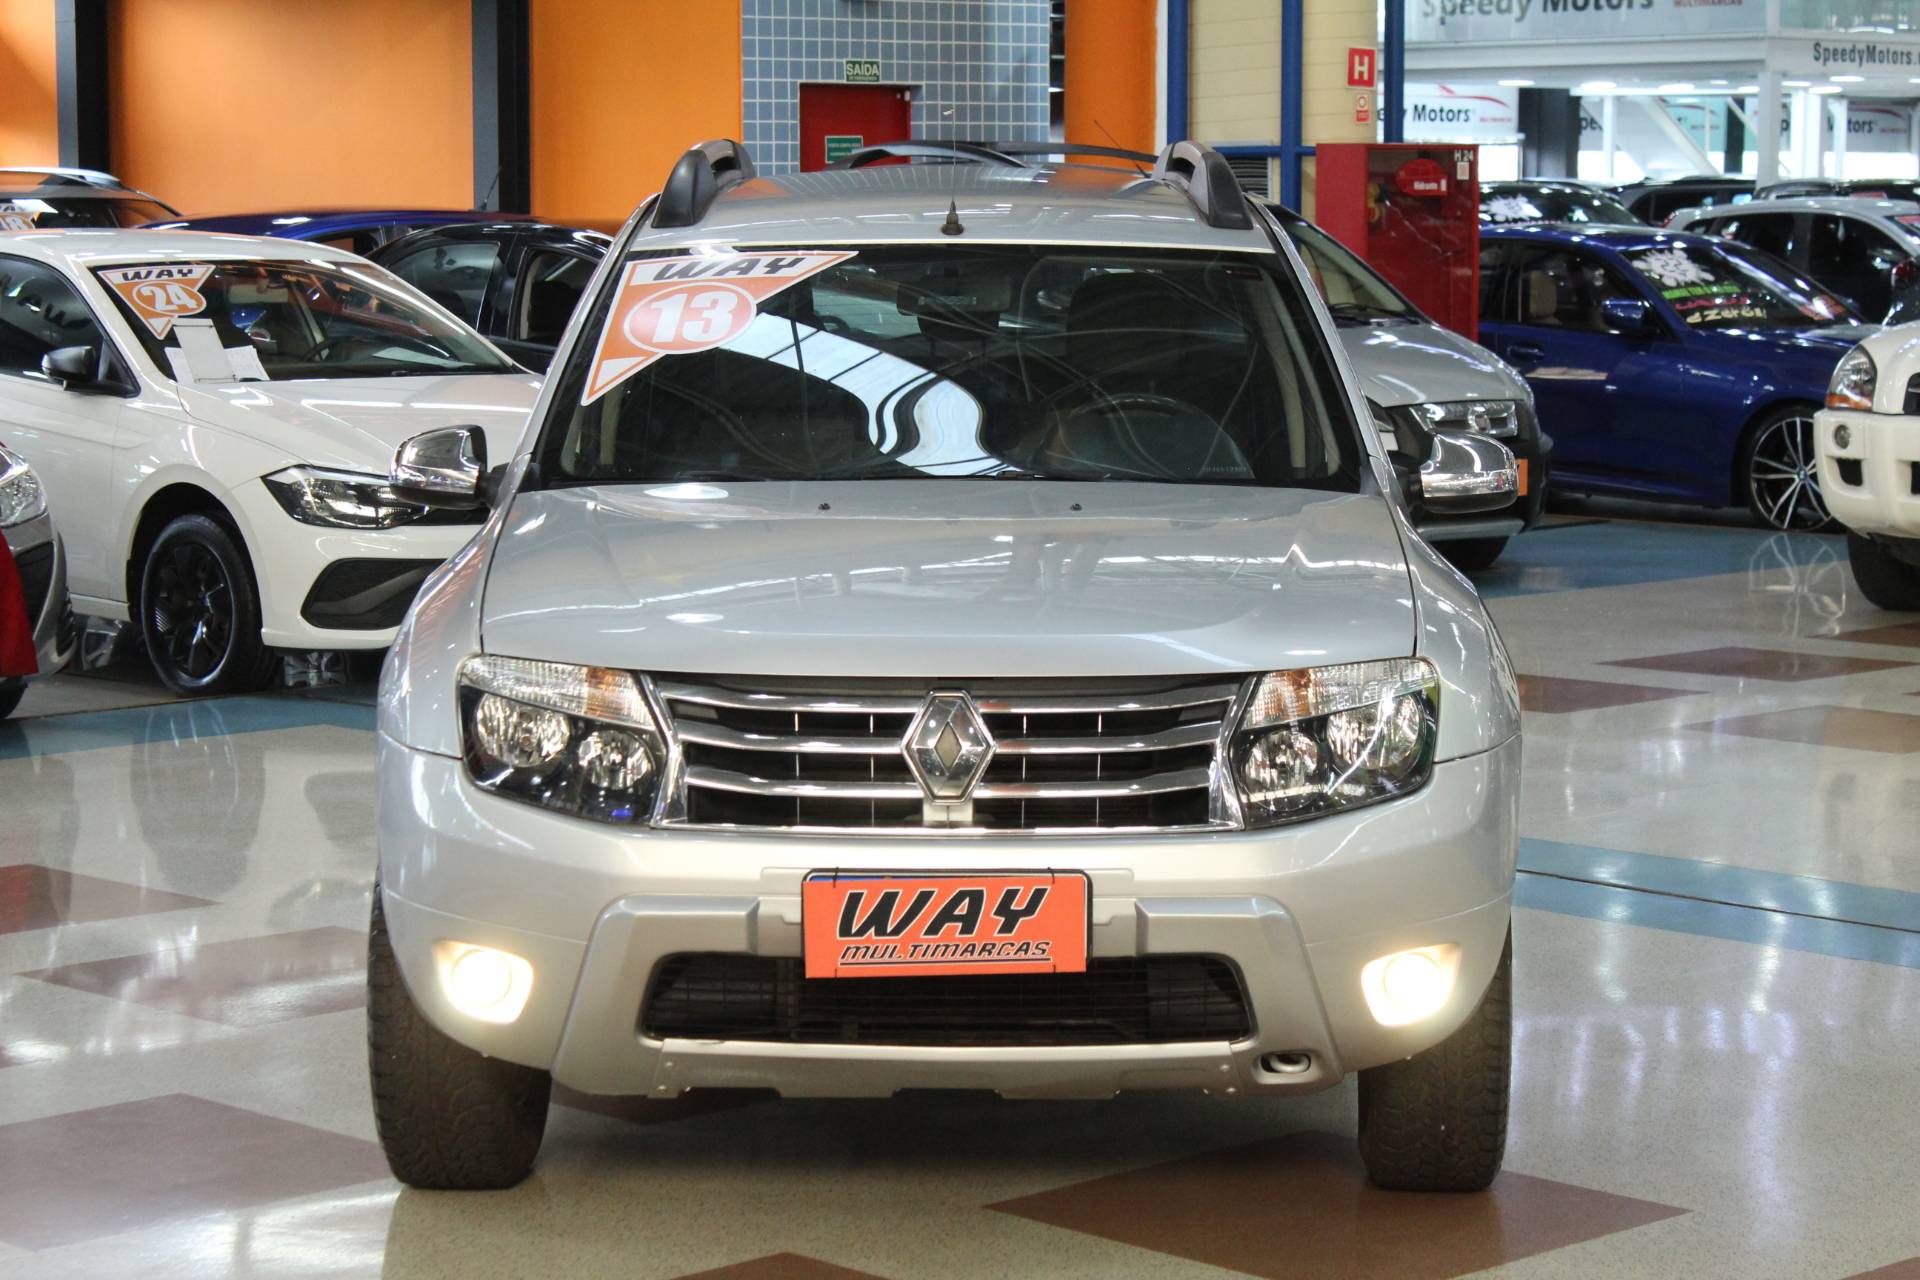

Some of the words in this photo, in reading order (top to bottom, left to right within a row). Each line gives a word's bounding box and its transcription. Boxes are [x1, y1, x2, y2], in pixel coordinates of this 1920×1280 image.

[1813, 42, 1920, 67] SpeedyMotors.
[846, 60, 880, 76] SAÍDA
[1354, 55, 1369, 81] H
[1413, 104, 1471, 122] Motors
[122, 268, 193, 281] WAY
[653, 257, 806, 282] WAY
[140, 285, 199, 311] 24
[651, 290, 738, 343] 13
[836, 885, 1051, 940] WAY
[840, 941, 1051, 961] MULTIMARCAS
